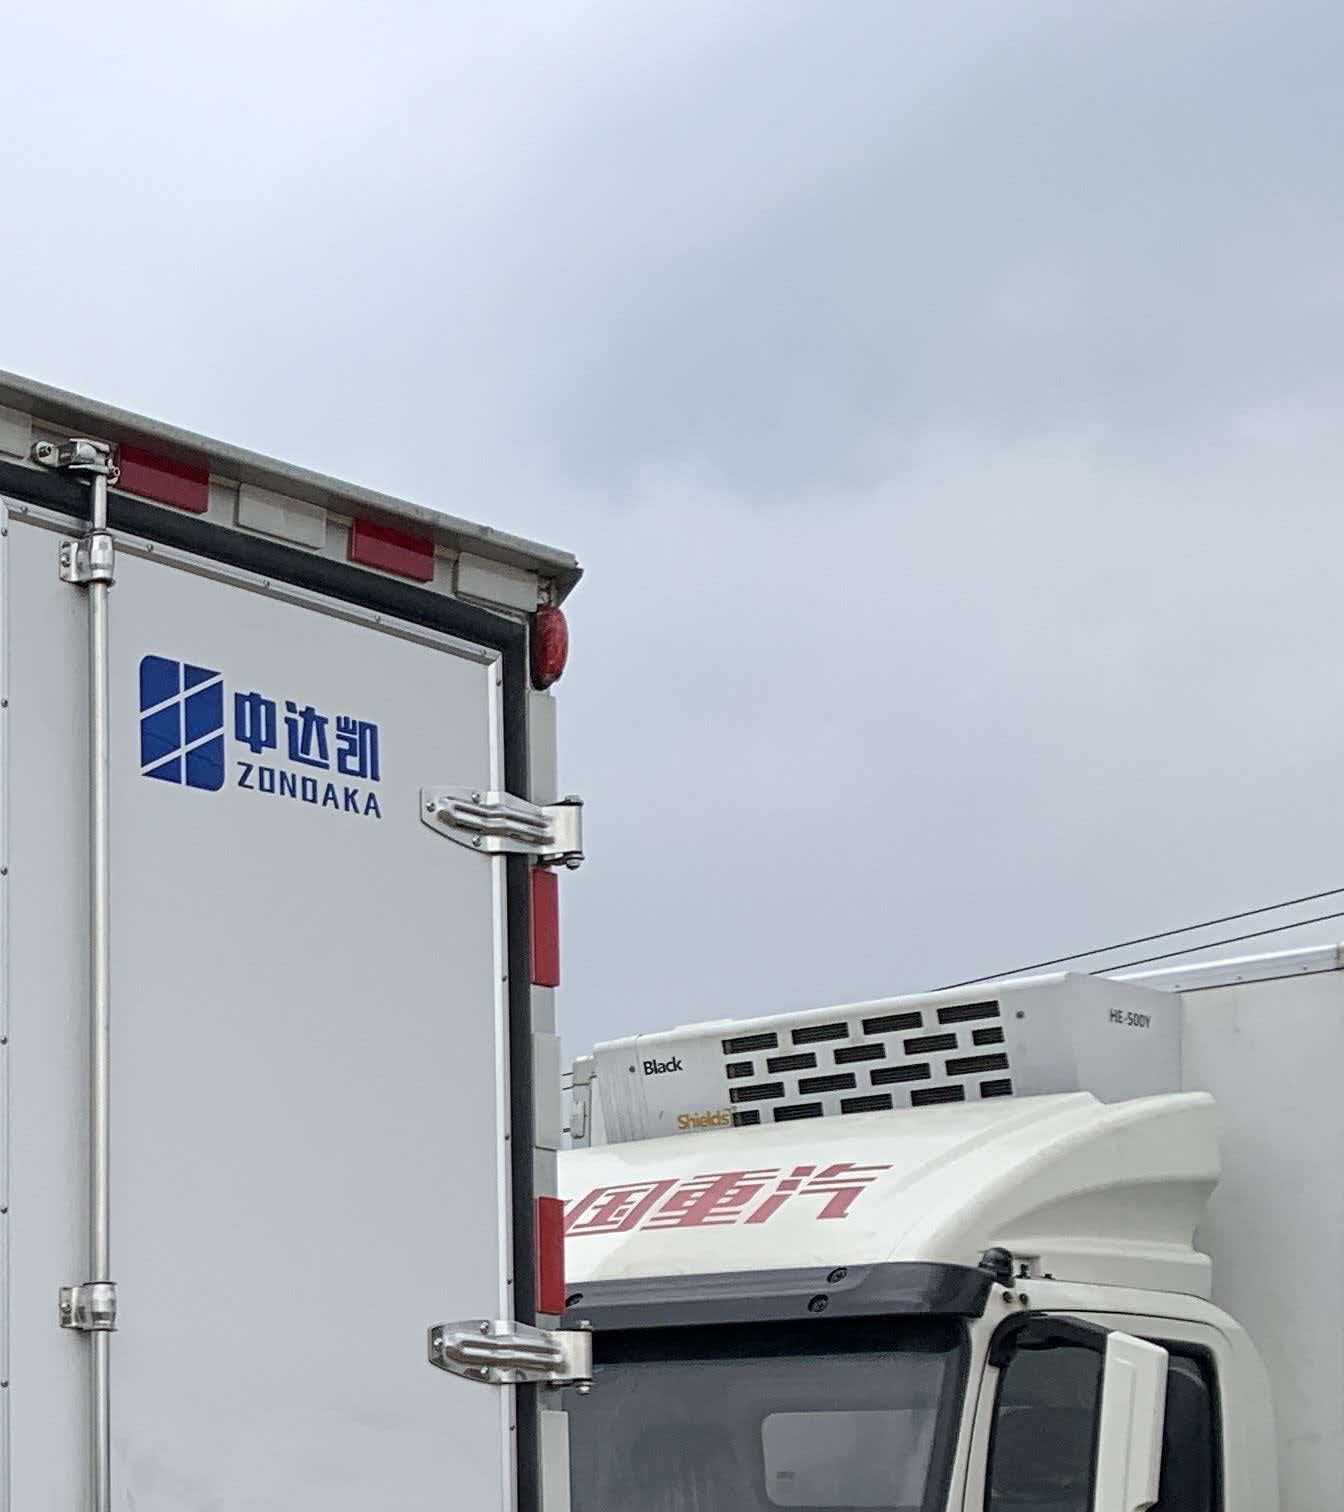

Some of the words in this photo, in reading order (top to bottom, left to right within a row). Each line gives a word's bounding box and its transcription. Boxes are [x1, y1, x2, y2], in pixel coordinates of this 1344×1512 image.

[234, 692, 381, 782] 中达凯
[642, 1056, 683, 1076] Black
[564, 1162, 894, 1238] 国重汽
